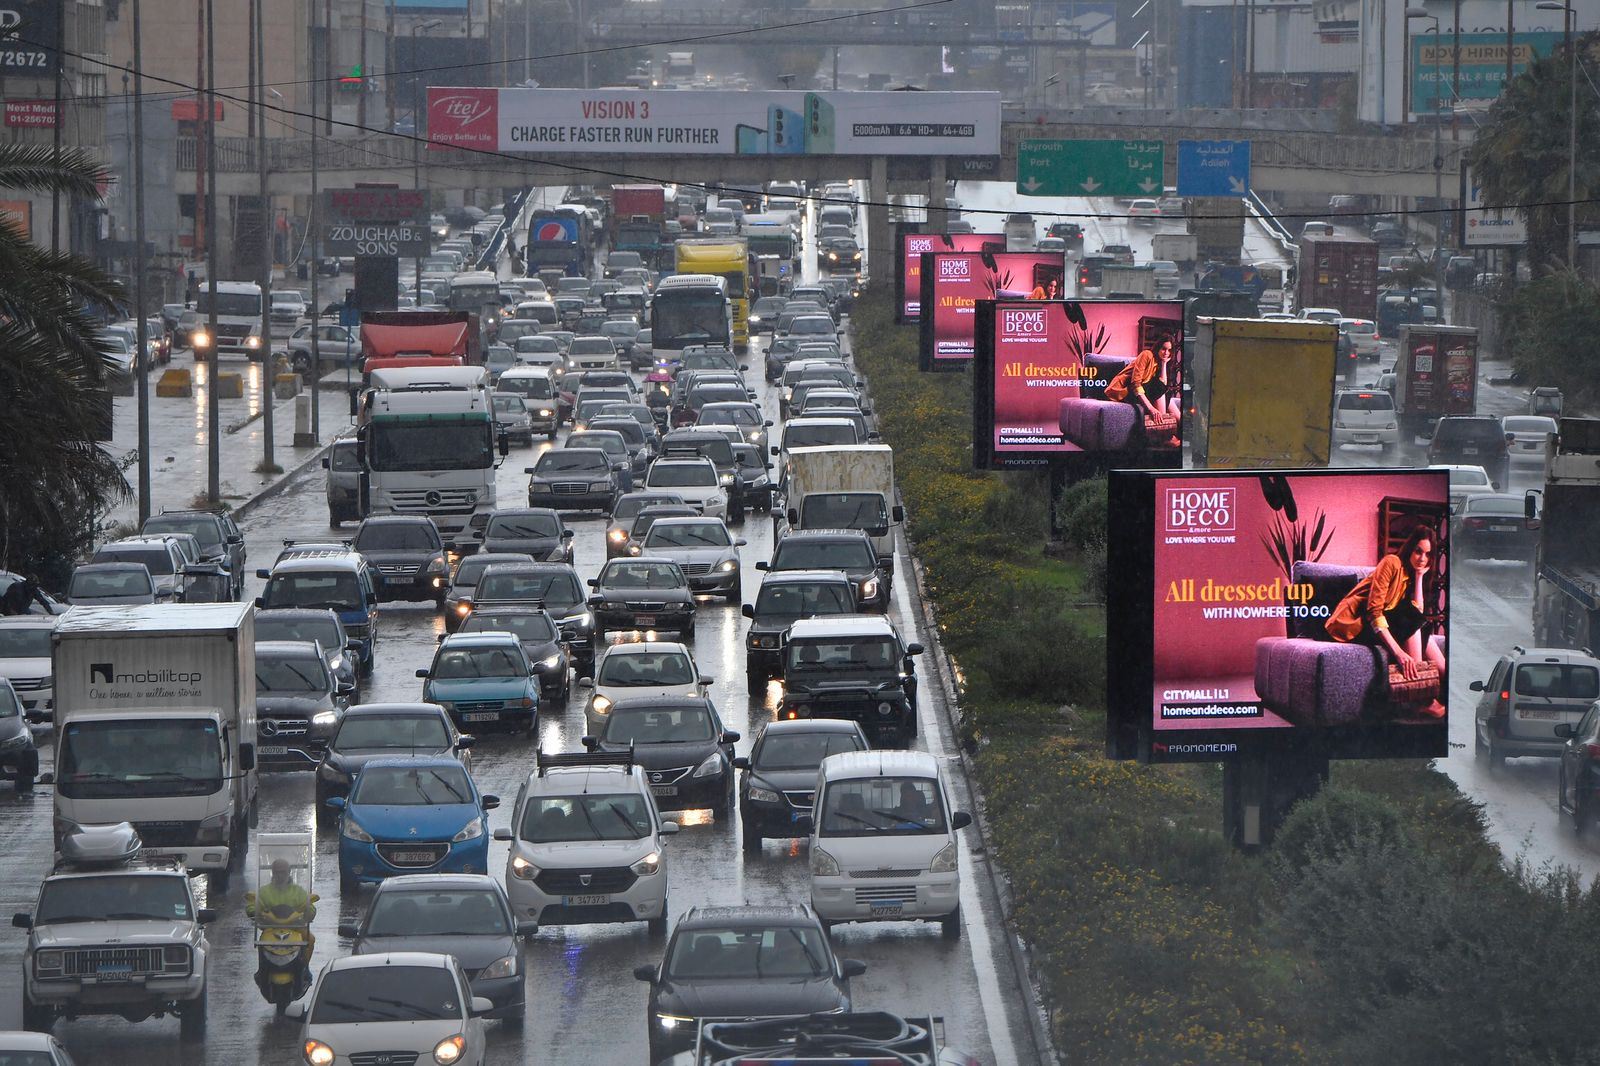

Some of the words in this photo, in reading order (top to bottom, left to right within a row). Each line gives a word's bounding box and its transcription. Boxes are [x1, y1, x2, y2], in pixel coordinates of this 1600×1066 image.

[1425, 48, 1461, 58] NOW
[1467, 46, 1526, 58] HIRING!
[7, 104, 30, 113] Next
[446, 100, 480, 114] itel
[582, 101, 635, 119] VISION
[641, 101, 649, 119] 3
[511, 126, 566, 142] CHARGE
[570, 127, 621, 142] FASTER
[625, 127, 652, 143] RUN
[657, 128, 719, 144] FURTHER
[855, 125, 891, 136] 5000mAh
[918, 126, 935, 136] HD+
[943, 126, 973, 136] 64+4GB
[432, 132, 453, 142] Enjoy
[455, 133, 477, 141] Better
[479, 133, 492, 141] Life
[1020, 141, 1063, 152] Beyrouth
[1123, 142, 1161, 154] بيروت
[1030, 158, 1051, 167] Port
[1128, 155, 1153, 171] مرفأ
[330, 227, 412, 241] ZOUGHAIB
[414, 232, 422, 241] &
[356, 241, 398, 255] SONS
[941, 260, 968, 268] HOME
[909, 267, 920, 276] All
[941, 267, 968, 275] DECO
[939, 298, 953, 307] All
[1006, 312, 1044, 323] HOME
[1006, 322, 1044, 332] DECO
[1002, 363, 1021, 377] All
[1025, 362, 1077, 377] dressed
[1080, 366, 1098, 379] up
[1026, 379, 1045, 387] WITH
[1046, 379, 1082, 387] NOWHERE
[1001, 436, 1061, 444] homeanddeco.com
[1172, 492, 1230, 509] HOME
[1172, 508, 1230, 526] DECO
[1165, 579, 1196, 602] All
[1200, 577, 1281, 601] dressed
[1287, 583, 1314, 604] up
[1202, 607, 1232, 619] WITH
[1233, 606, 1290, 619] NOWHERE
[1292, 606, 1309, 618] TO
[1310, 605, 1332, 617] GO.
[116, 669, 202, 686] mobilitop
[90, 687, 106, 699] One
[146, 687, 175, 698] million
[178, 687, 202, 697] stories
[1163, 689, 1214, 700] CITYMALL
[1219, 689, 1229, 699] L1
[1163, 704, 1258, 716] homeanddeco.com
[1168, 743, 1238, 753] PROMOMEDIA
